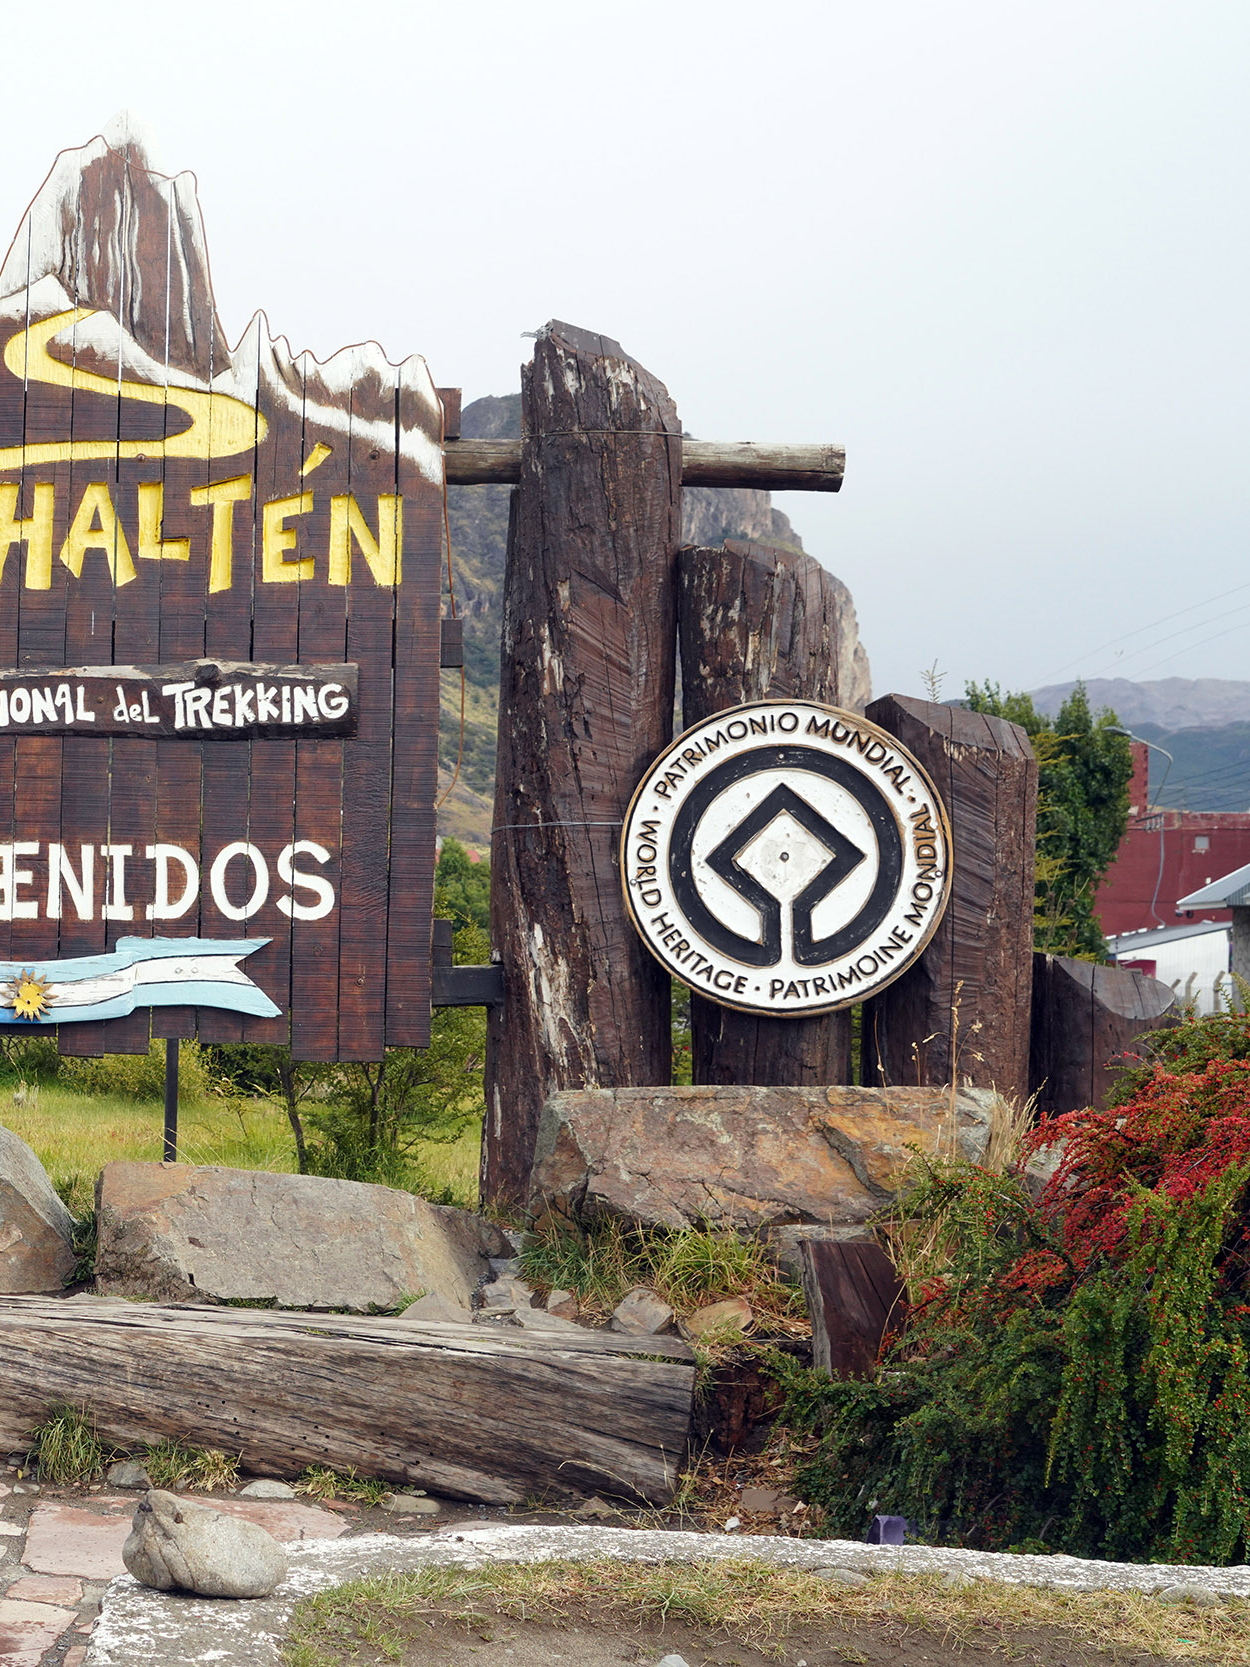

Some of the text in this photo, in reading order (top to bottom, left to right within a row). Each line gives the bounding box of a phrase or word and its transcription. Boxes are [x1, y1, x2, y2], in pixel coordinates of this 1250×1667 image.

[162, 681, 350, 729] TREKKING
[654, 711, 913, 801] PATRIMONIO MUNDIAL
[636, 820, 749, 995] WORLD HERITAGE
[769, 802, 939, 1000] PATRIMOINE MONDIAL
